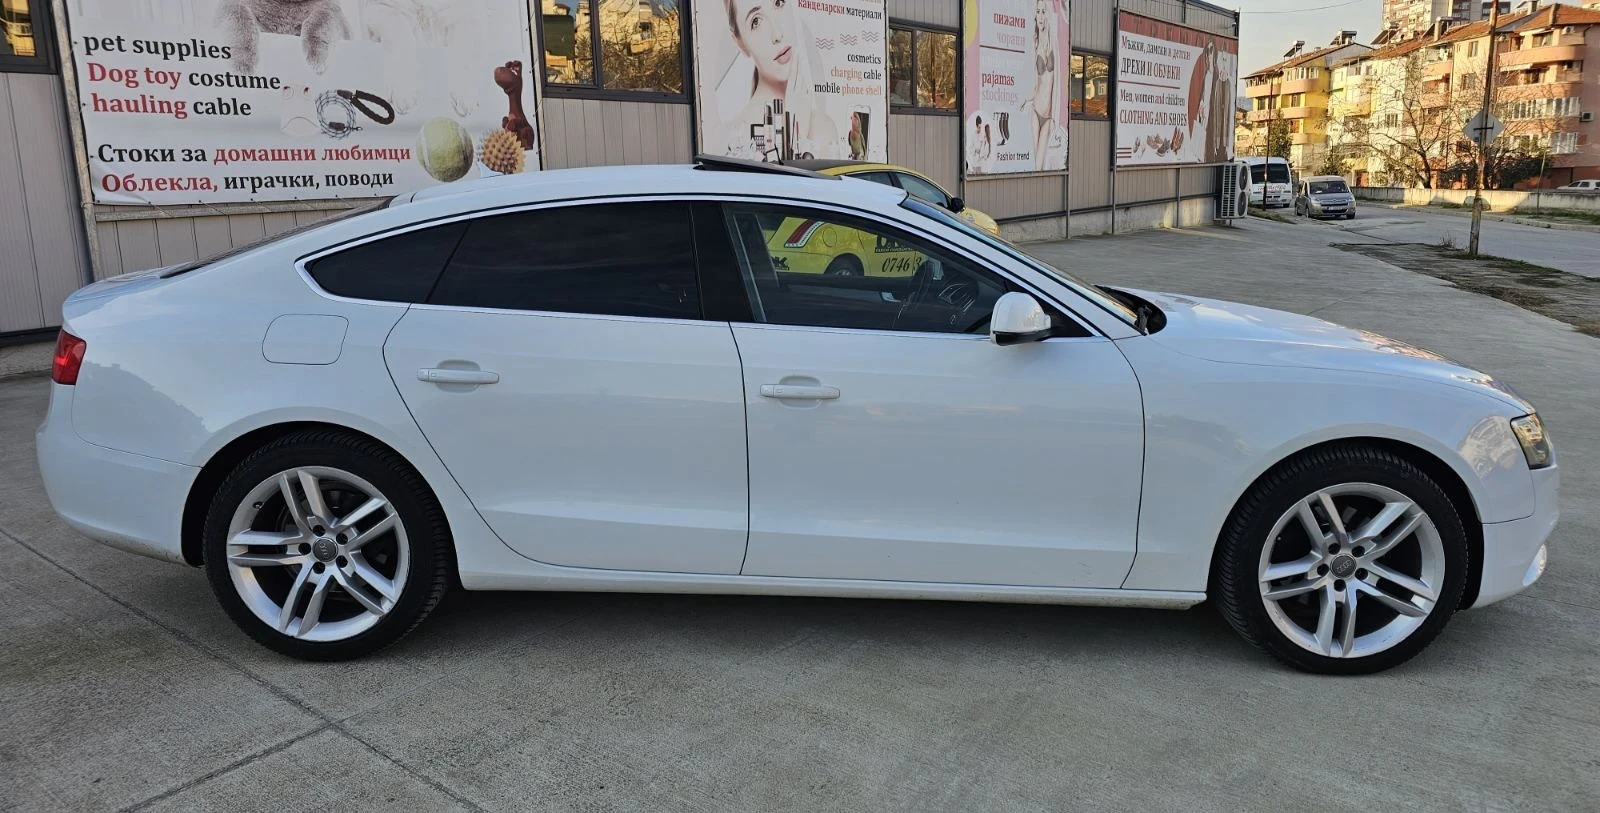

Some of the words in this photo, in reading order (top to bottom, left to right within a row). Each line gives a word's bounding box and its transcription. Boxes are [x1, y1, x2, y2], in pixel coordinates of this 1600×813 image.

[846, 7, 882, 20] материали
[82, 36, 127, 55] pet
[132, 39, 231, 61] supplies
[847, 53, 882, 64] cosmetics
[87, 63, 140, 88] Dog
[144, 67, 182, 90] toy
[188, 72, 281, 89] costume
[831, 66, 863, 81] charging
[863, 69, 882, 80] cable
[1120, 58, 1146, 76] ДРЕХИ
[1147, 61, 1152, 76] И
[1153, 63, 1181, 80] ОБУВКИ
[982, 71, 1015, 88] pajamas
[814, 82, 841, 94] mobile
[841, 83, 864, 96] phone
[982, 87, 1019, 105] stockings
[1120, 89, 1134, 104] Men,
[1134, 92, 1154, 104] women
[1155, 93, 1165, 105] and
[1165, 94, 1186, 106] children
[91, 93, 188, 119] hauling
[193, 97, 252, 116] cable
[1120, 109, 1154, 125] CLOTHING
[1154, 111, 1168, 126] AND
[1168, 112, 1188, 127] SHOES
[98, 144, 176, 163] Стоки
[181, 148, 208, 162] за
[213, 148, 317, 166] домашни
[321, 145, 411, 163] любимци
[996, 152, 1016, 161] Fashion
[1016, 151, 1030, 161] trend
[101, 173, 219, 193] Облекла,
[223, 174, 320, 194] играчки,
[324, 172, 394, 188] поводи
[881, 257, 911, 273] 0746
